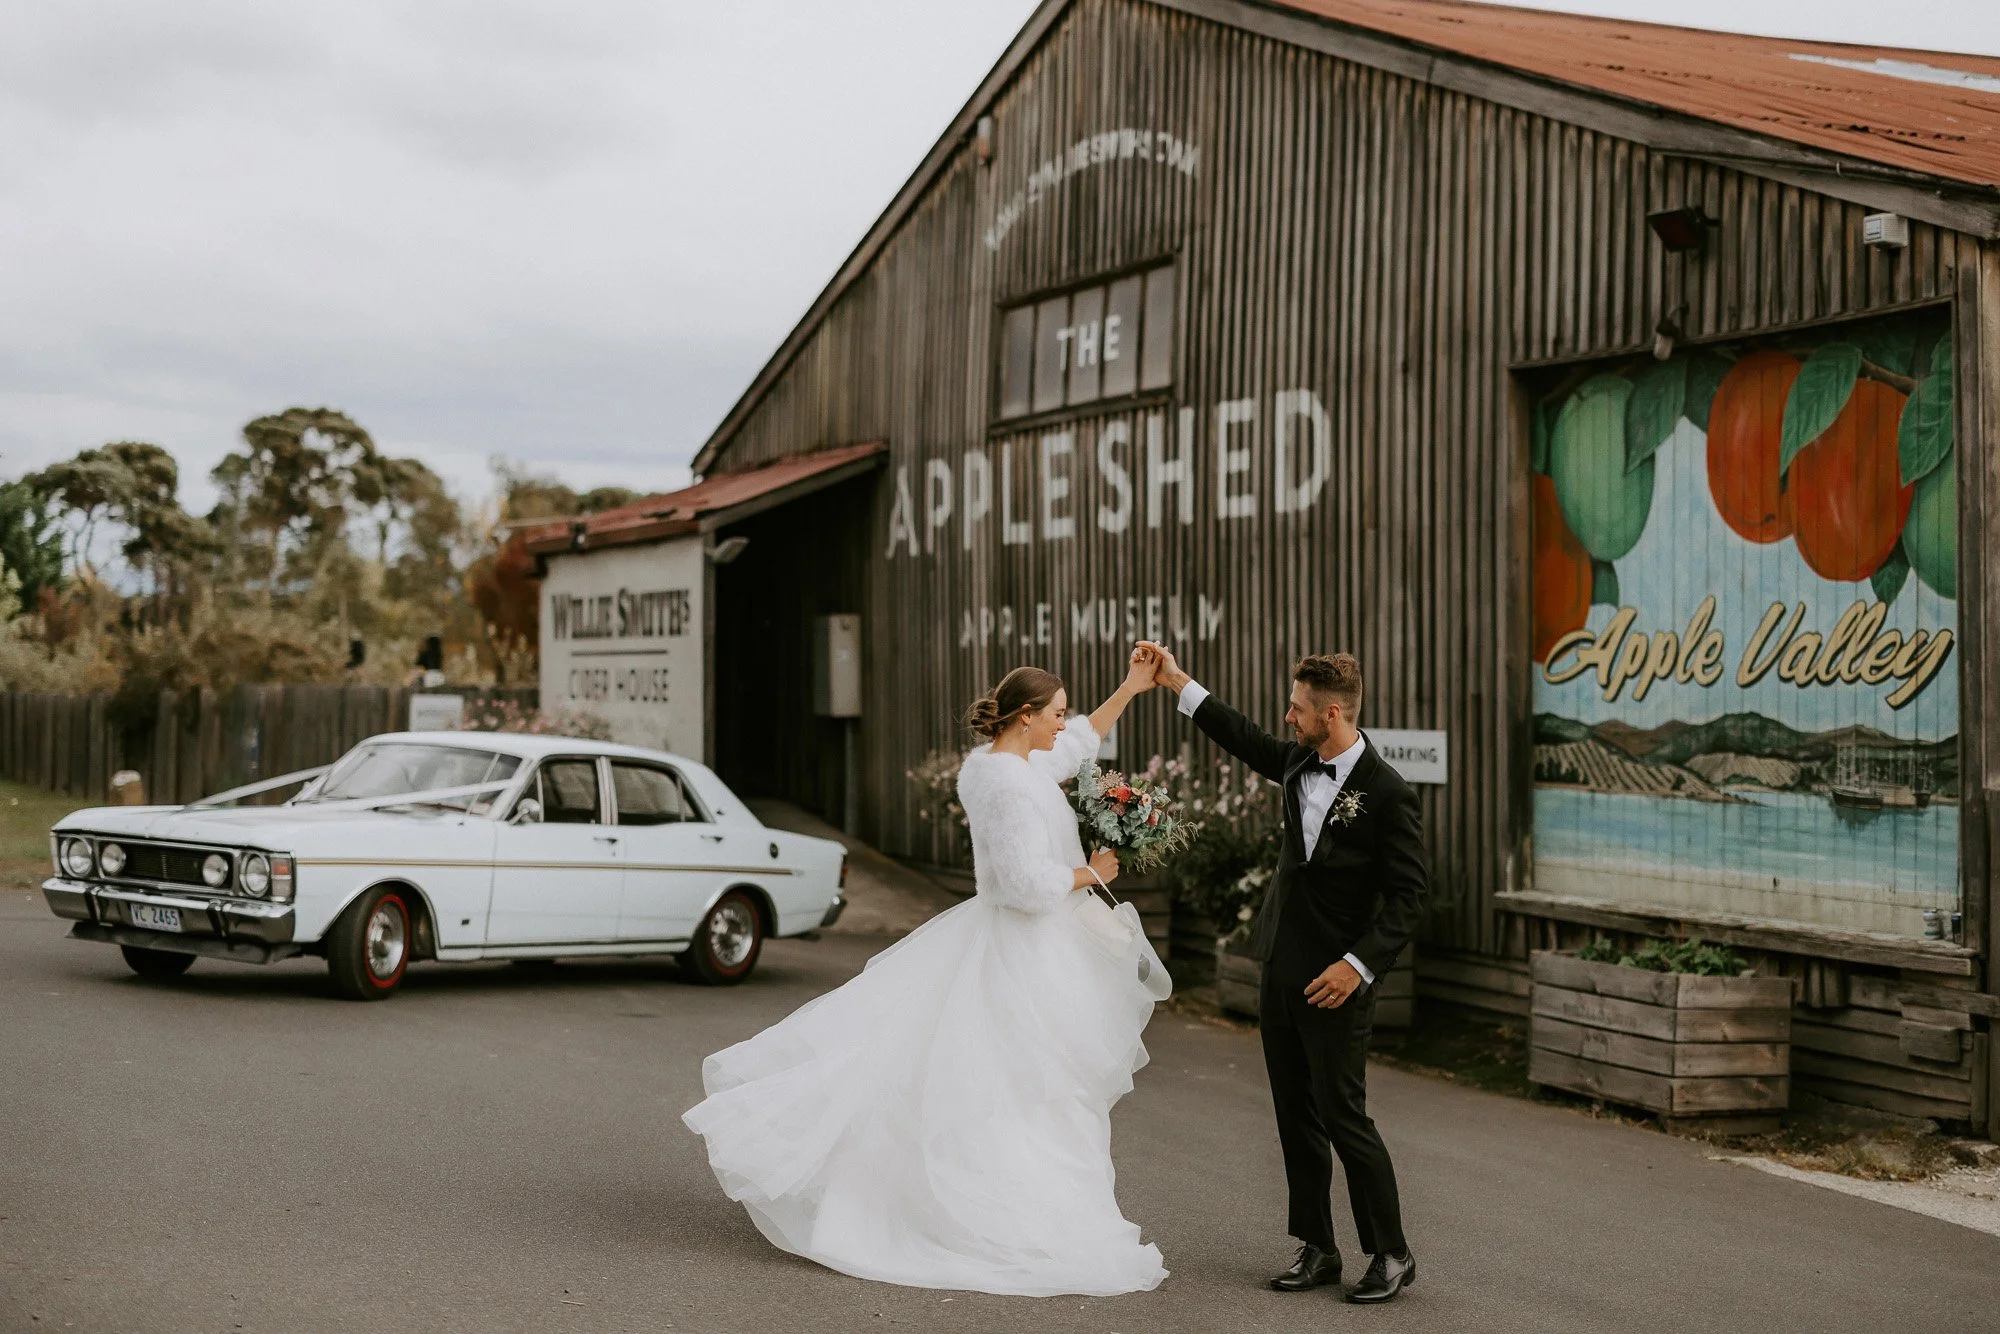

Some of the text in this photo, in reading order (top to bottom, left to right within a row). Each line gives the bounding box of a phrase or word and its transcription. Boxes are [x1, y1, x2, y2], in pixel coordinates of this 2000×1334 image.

[1056, 314, 1121, 371] THE
[885, 389, 1331, 559] APPLE SHED
[959, 594, 1224, 648] APPLE MUSEUM
[1543, 596, 1955, 710] Apple Valley
